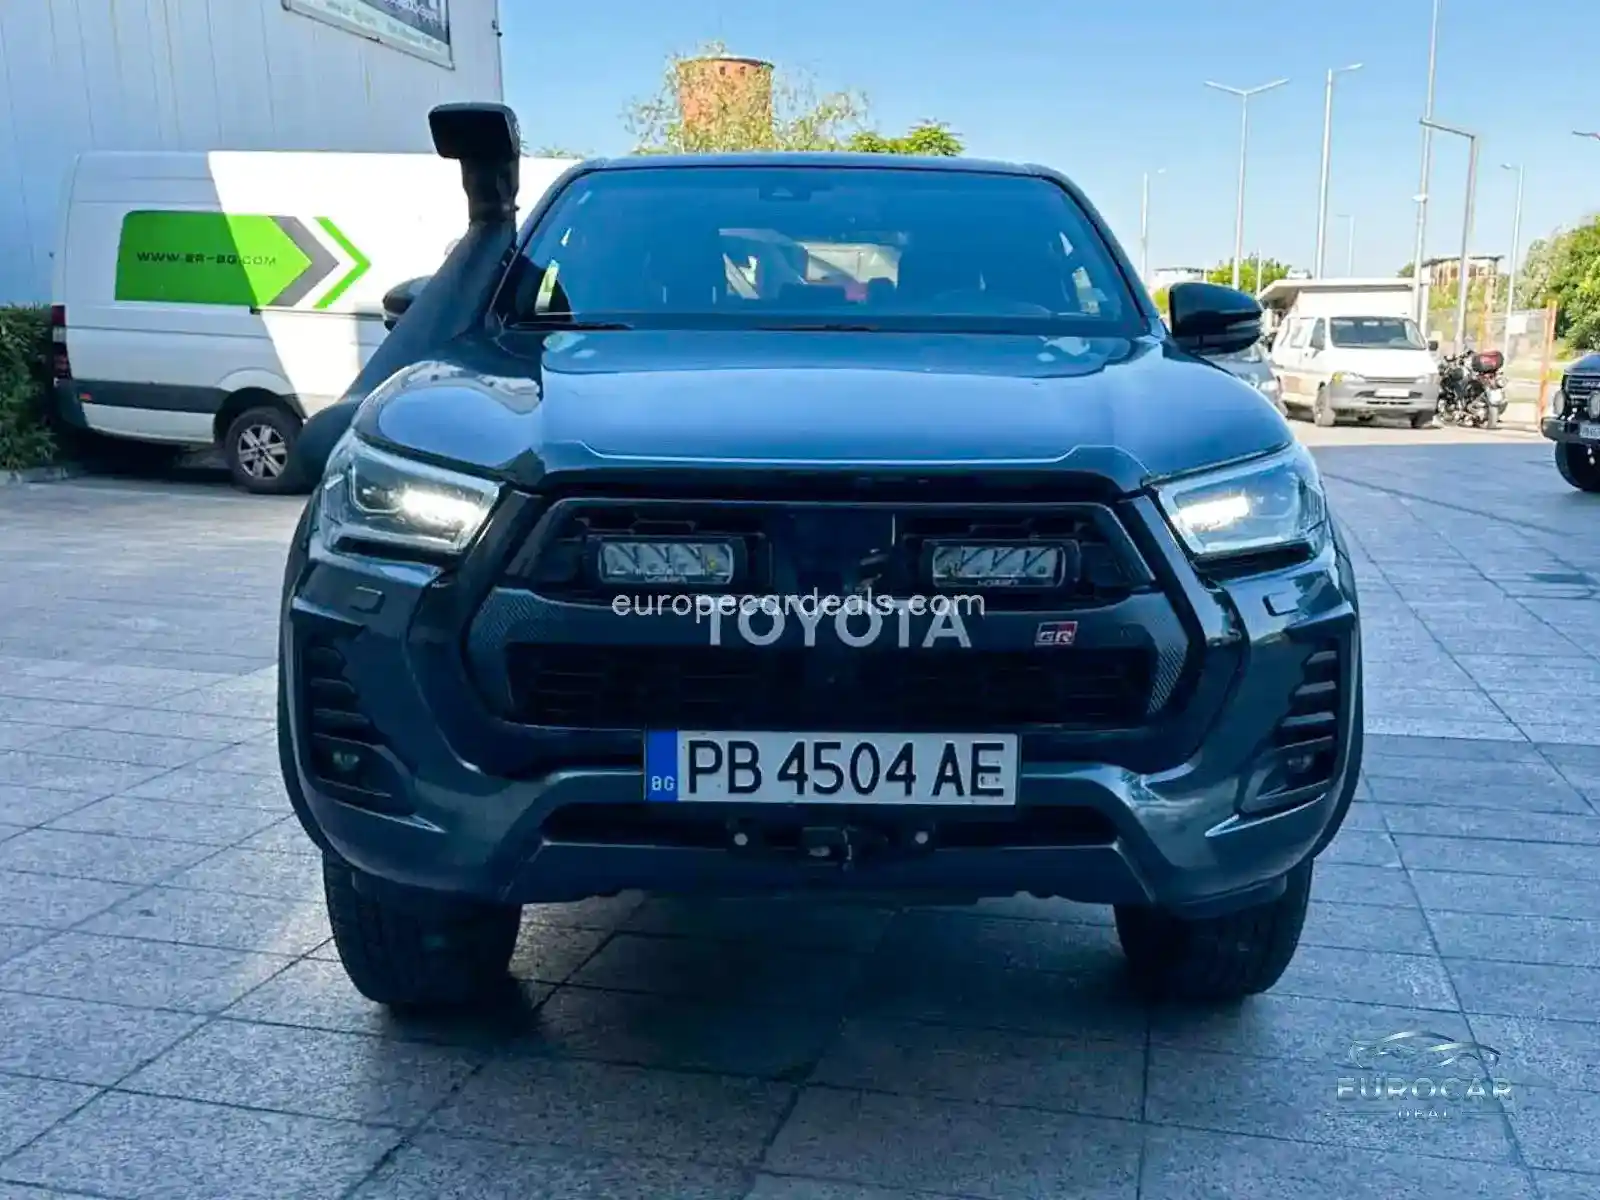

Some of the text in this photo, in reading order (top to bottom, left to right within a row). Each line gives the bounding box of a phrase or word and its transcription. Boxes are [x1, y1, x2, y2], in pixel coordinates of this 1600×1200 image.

[696, 597, 972, 648] TOYOTA
[1038, 629, 1074, 645] GR
[651, 775, 676, 791] BG
[688, 740, 1004, 797] PB 4504 AE
